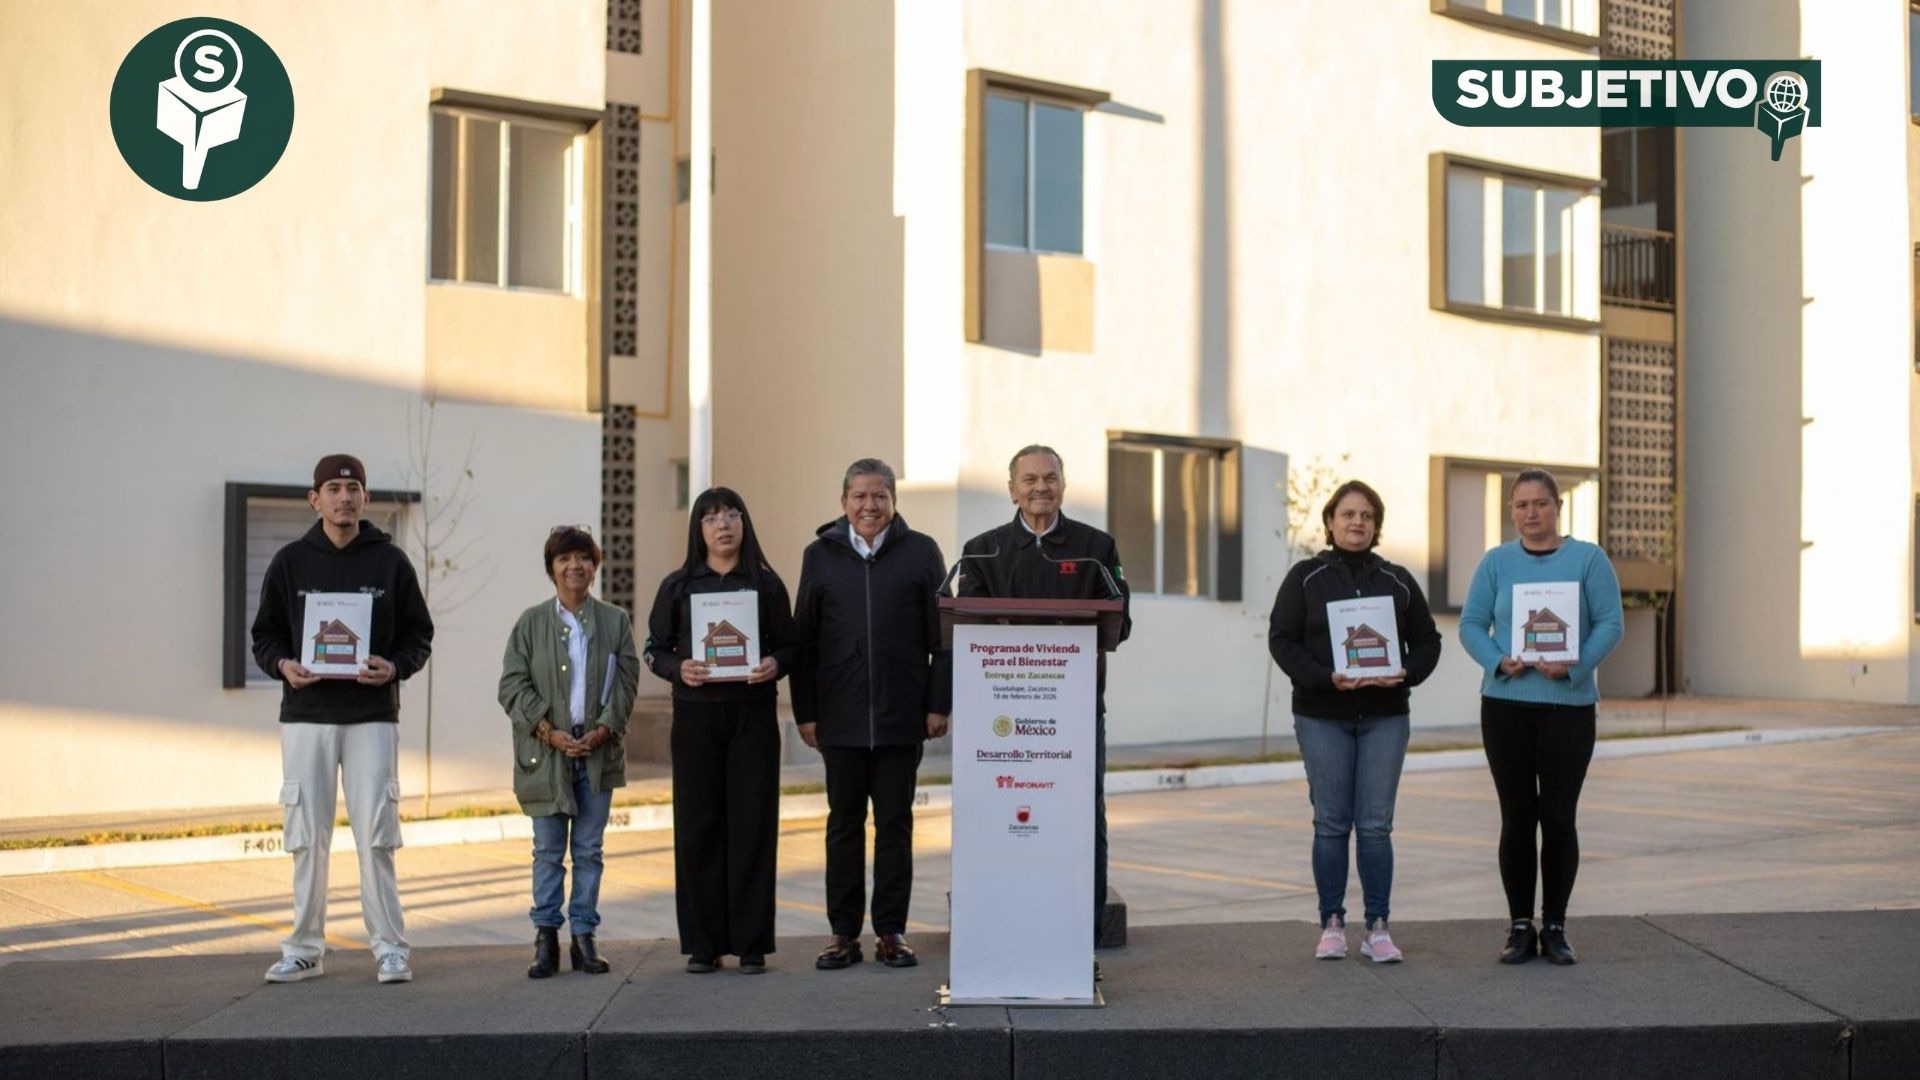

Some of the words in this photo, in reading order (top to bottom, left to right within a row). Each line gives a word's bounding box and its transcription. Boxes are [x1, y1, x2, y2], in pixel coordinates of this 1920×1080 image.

[970, 643, 1021, 655] Programa
[1022, 644, 1034, 653] de
[1036, 643, 1080, 653] Vivienda
[982, 658, 1005, 668] para
[1007, 657, 1016, 666] el
[1018, 657, 1068, 667] Bienestar
[985, 671, 1014, 680] Entrega
[1028, 671, 1065, 679] Zacatecas
[1014, 717, 1047, 725] Gobierno
[1048, 717, 1057, 725] de
[1014, 725, 1057, 736] México
[976, 749, 1025, 759] Desarrollo
[1025, 749, 1072, 759] Territorial
